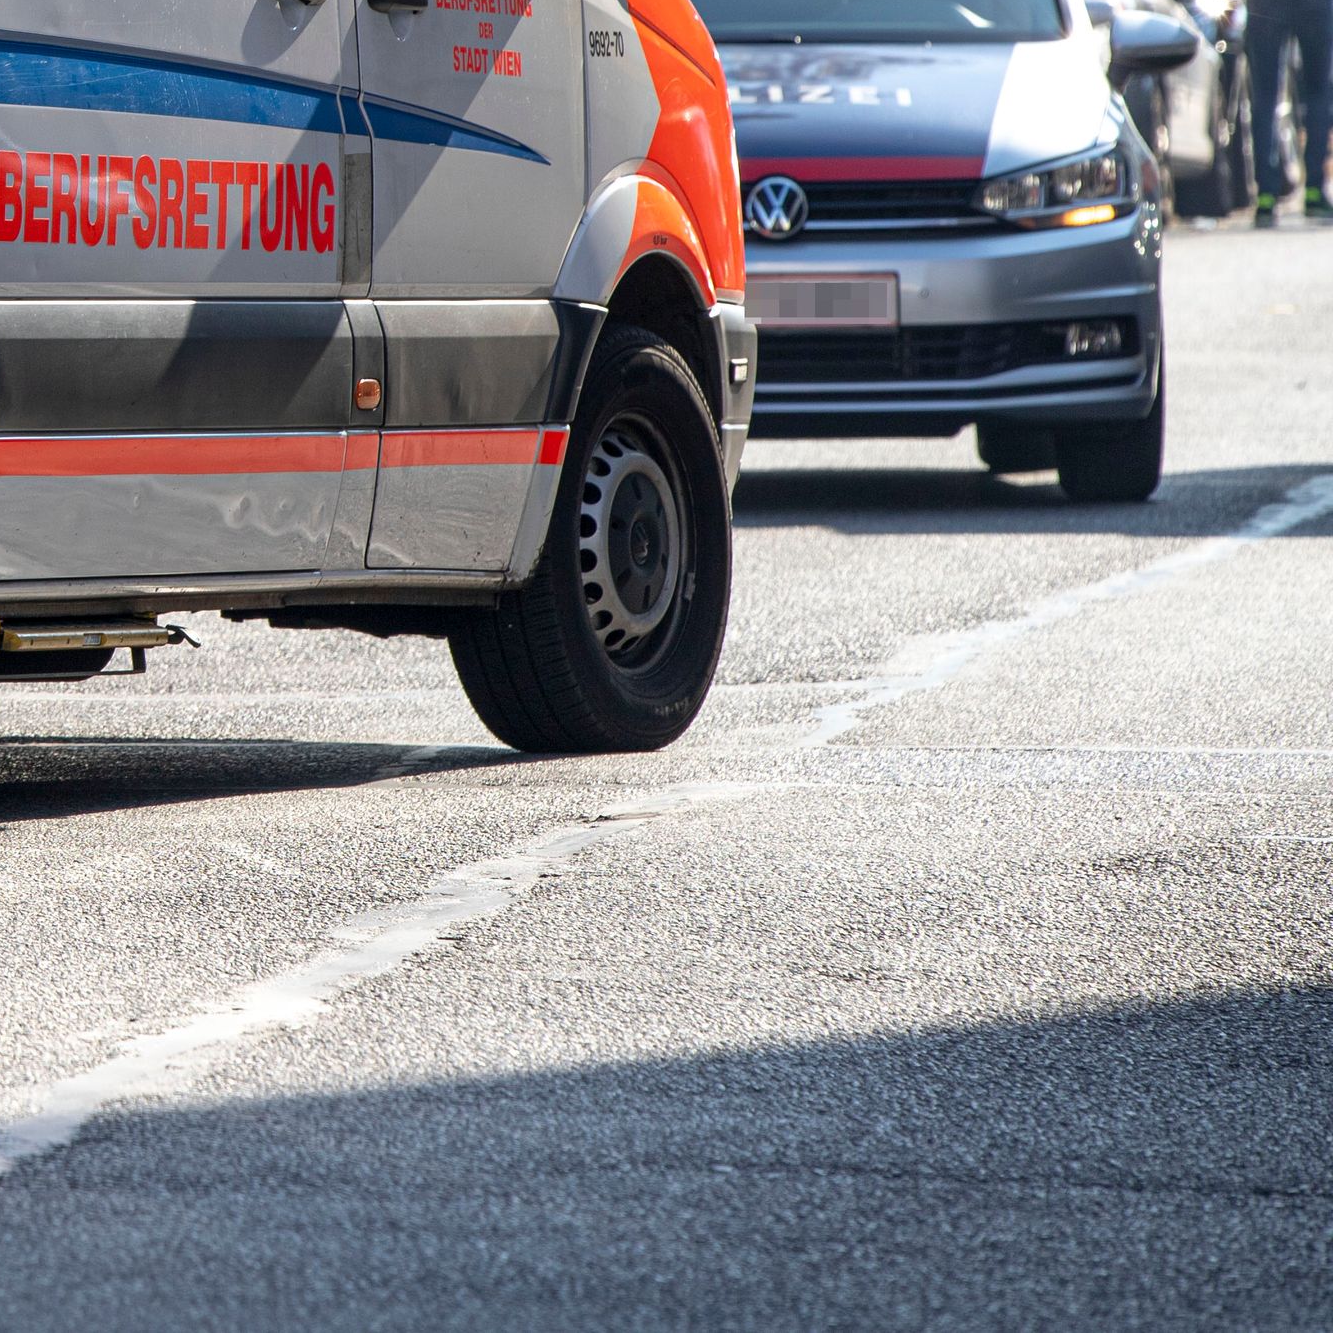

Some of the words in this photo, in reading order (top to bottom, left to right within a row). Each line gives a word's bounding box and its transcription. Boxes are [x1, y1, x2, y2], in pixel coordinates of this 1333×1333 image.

[478, 22, 494, 40] DER
[589, 30, 625, 57] 9692-70
[452, 46, 489, 75] STADT
[493, 49, 522, 77] WIEN
[730, 84, 912, 108] LIZEI
